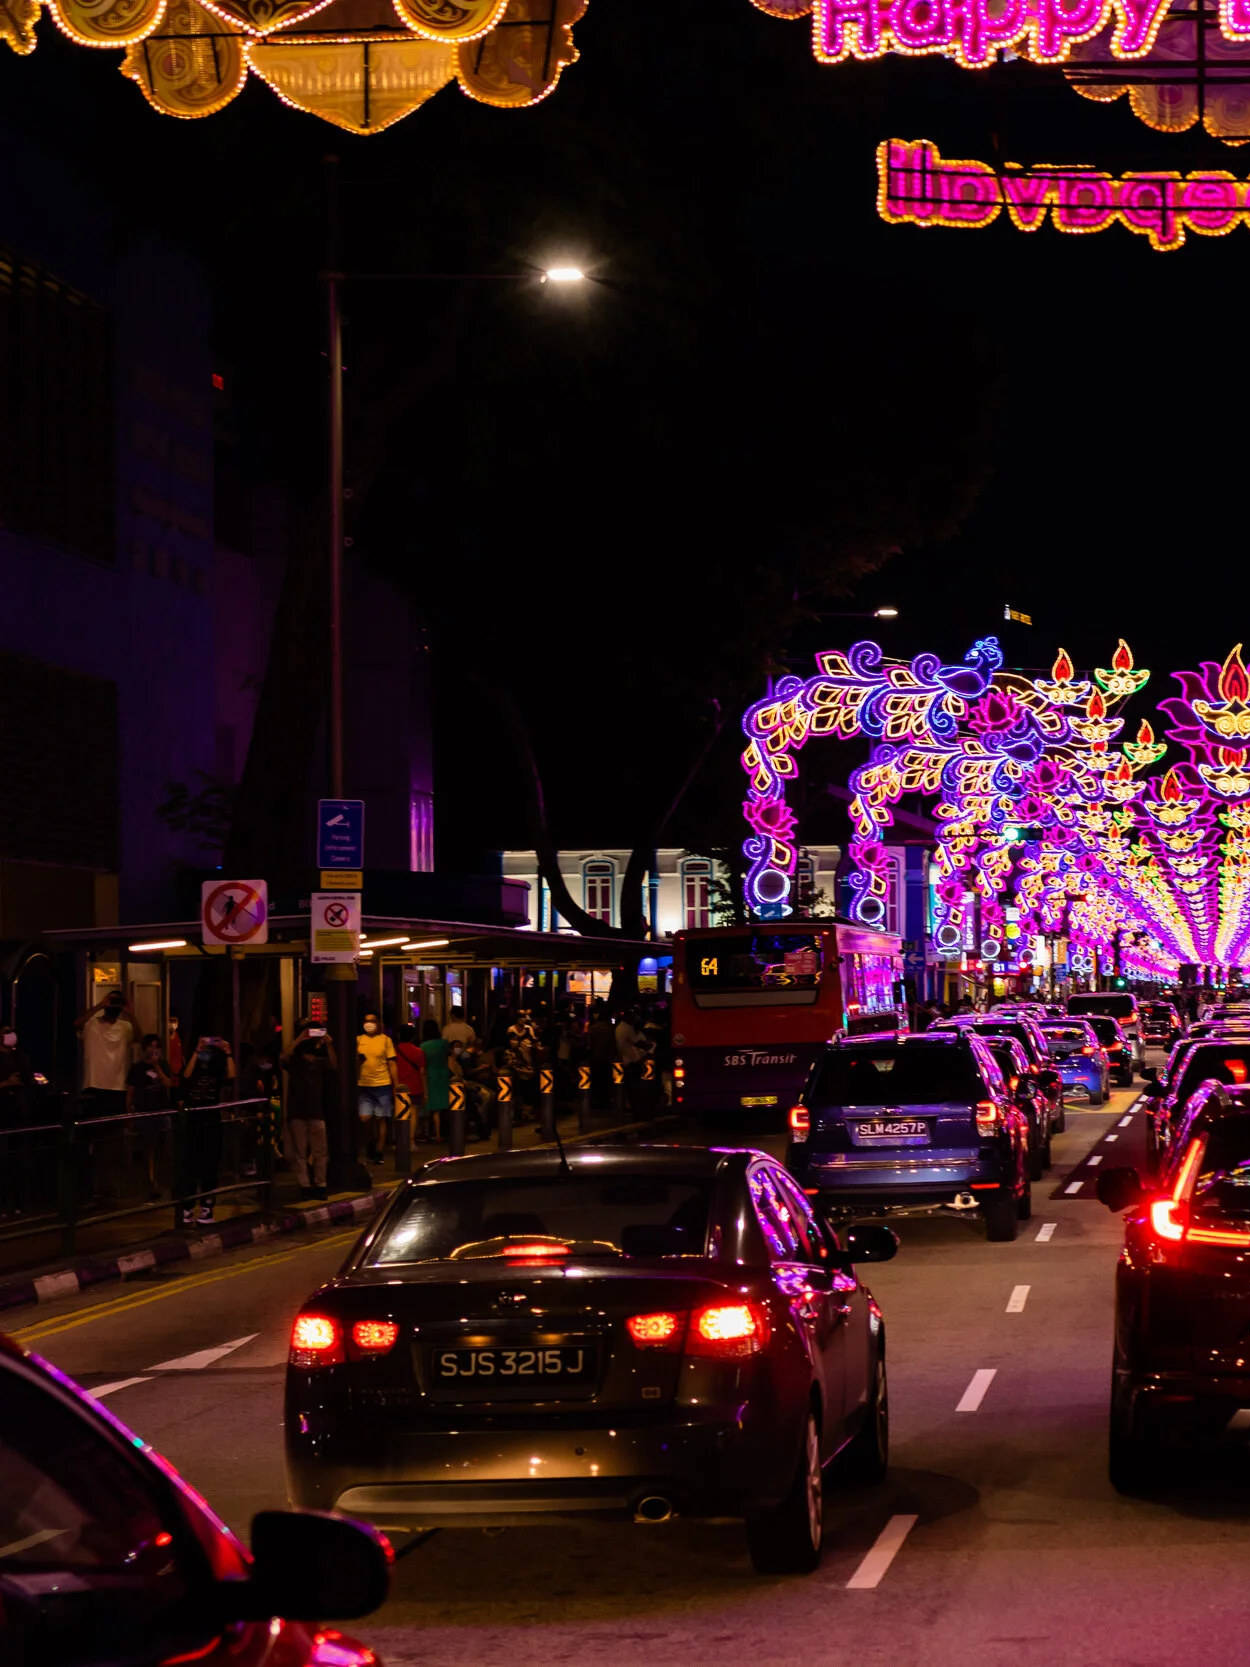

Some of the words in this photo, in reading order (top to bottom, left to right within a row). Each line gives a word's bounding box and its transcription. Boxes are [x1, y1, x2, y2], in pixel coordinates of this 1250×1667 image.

[701, 957, 718, 976] 64
[724, 1055, 746, 1066] SBS
[748, 1050, 797, 1067] Transit
[859, 1121, 926, 1135] SLM4257P
